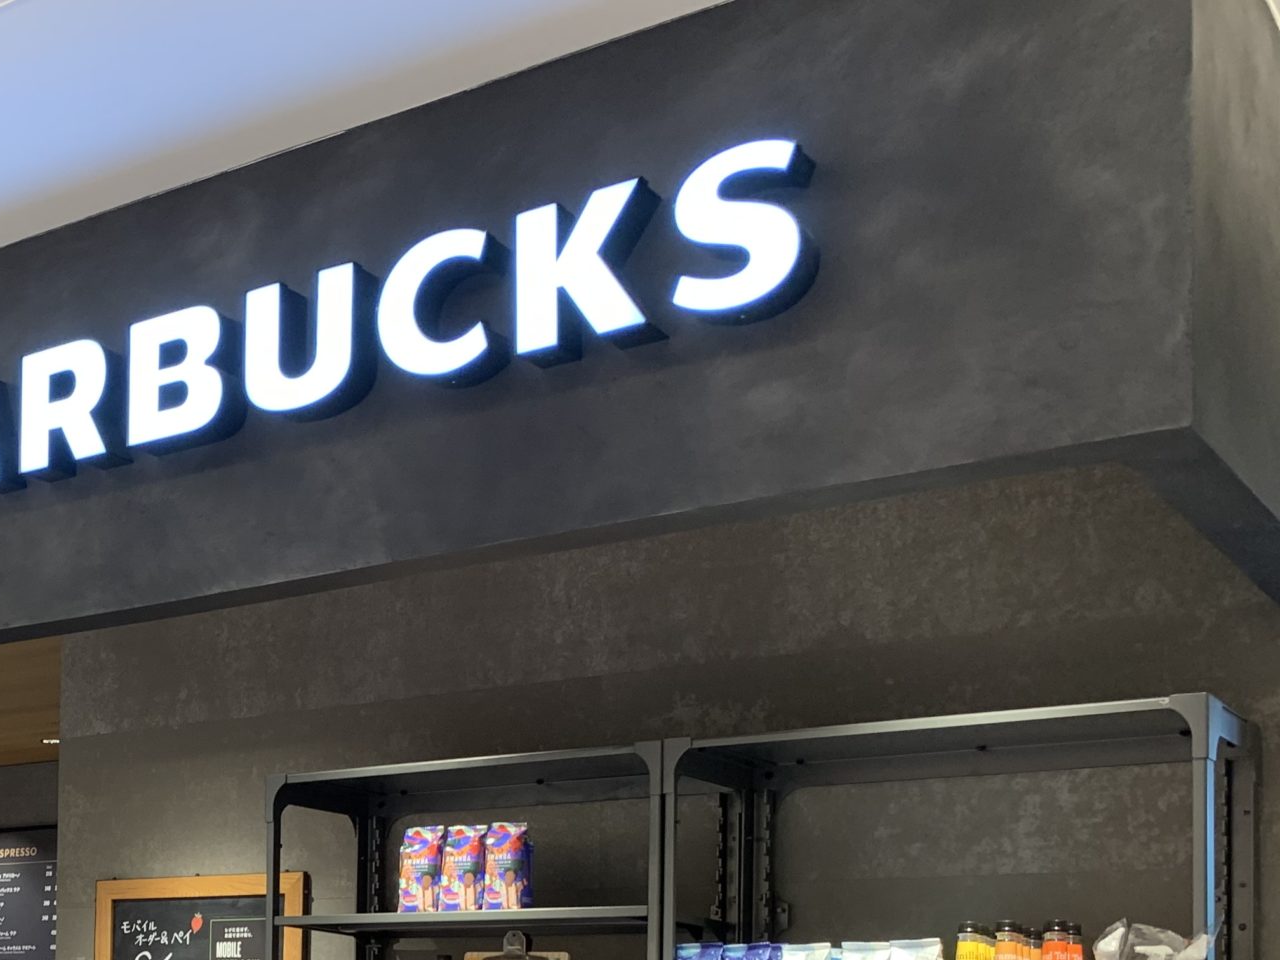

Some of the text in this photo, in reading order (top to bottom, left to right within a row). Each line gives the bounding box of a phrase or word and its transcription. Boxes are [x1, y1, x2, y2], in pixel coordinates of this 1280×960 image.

[121, 920, 157, 934] モバイル
[216, 941, 242, 958] MOBILE
